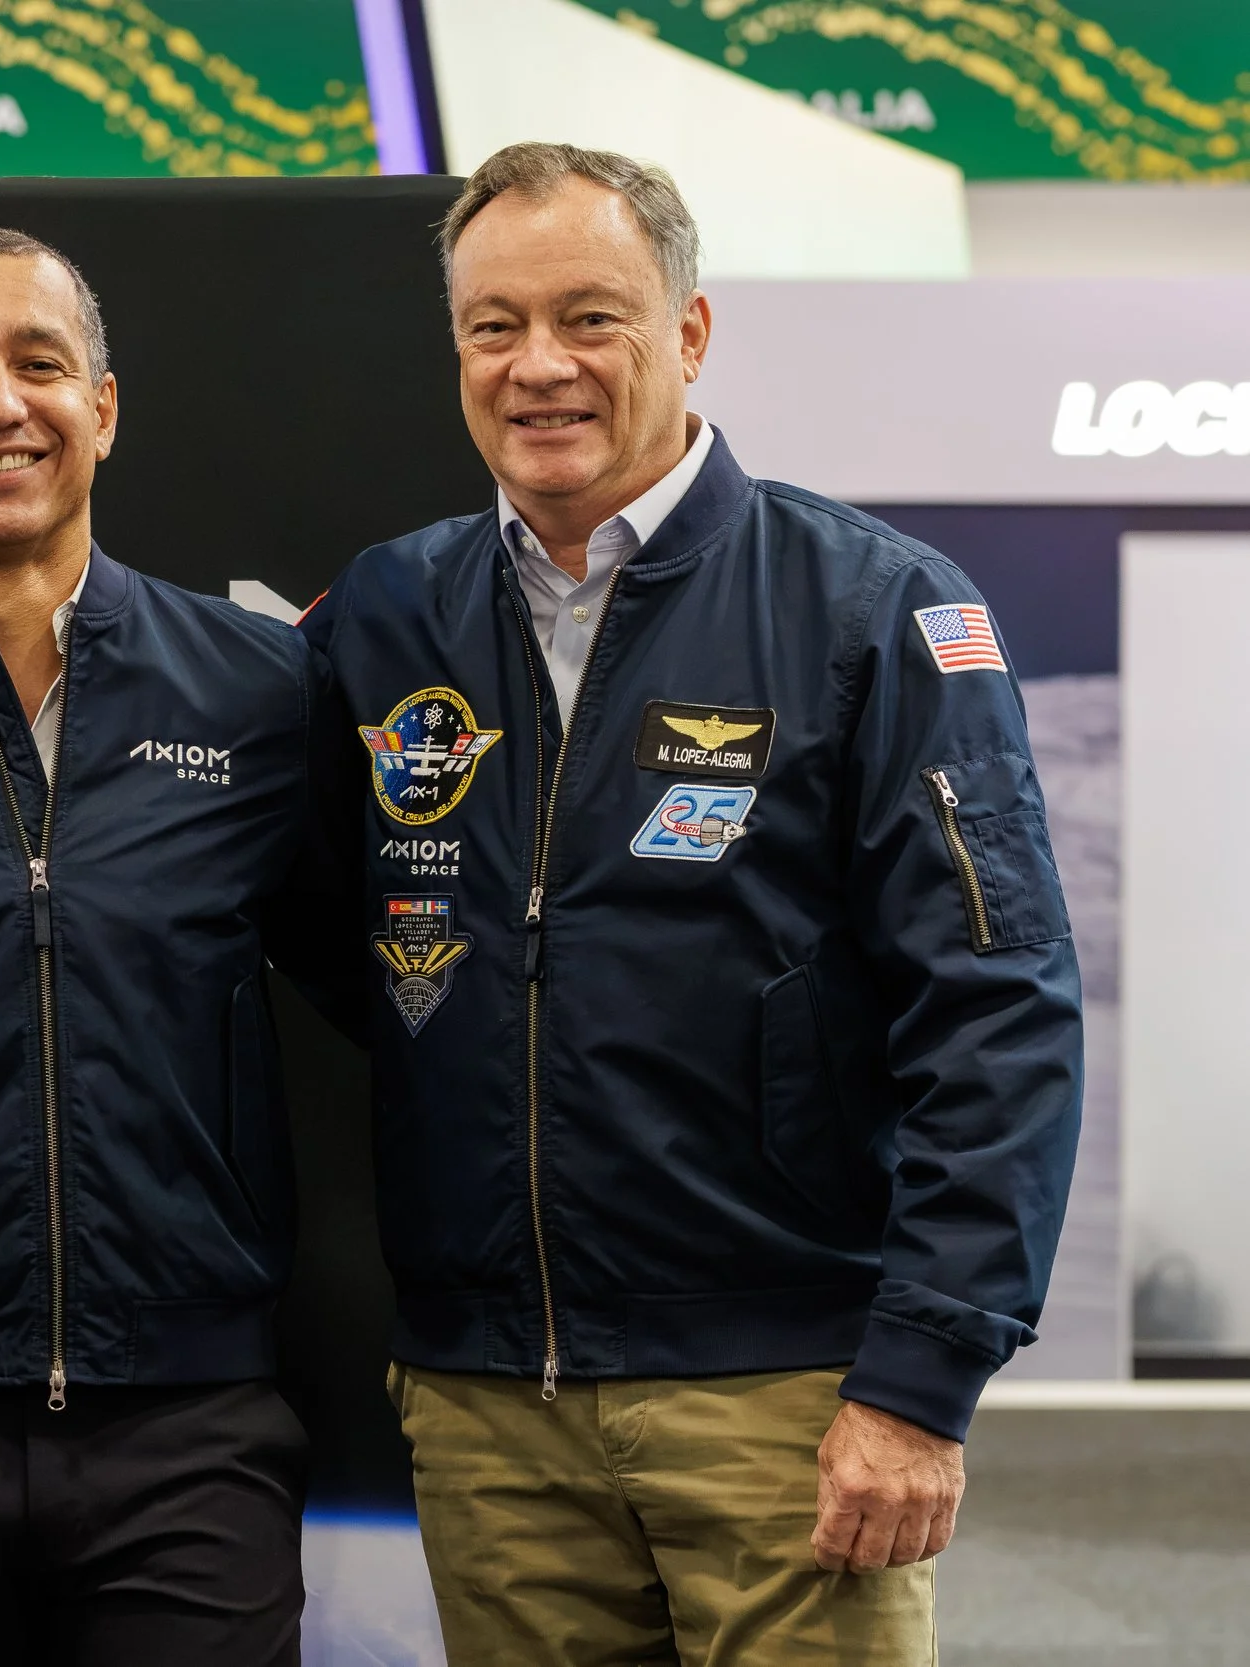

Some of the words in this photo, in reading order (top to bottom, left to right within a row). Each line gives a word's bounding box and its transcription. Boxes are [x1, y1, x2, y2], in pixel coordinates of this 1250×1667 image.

[130, 740, 230, 770] AXIOM
[657, 744, 670, 761] M.
[673, 746, 752, 770] LOPEZ-ALEGRIA
[177, 768, 230, 785] SPACE
[399, 785, 439, 800] AX-1
[382, 793, 404, 817] PRIVATE
[405, 812, 425, 821] CREW
[425, 811, 435, 819] TO
[650, 794, 737, 849] 25
[673, 823, 699, 834] MACH
[380, 840, 460, 860] AXIOM
[411, 865, 459, 875] SPACE
